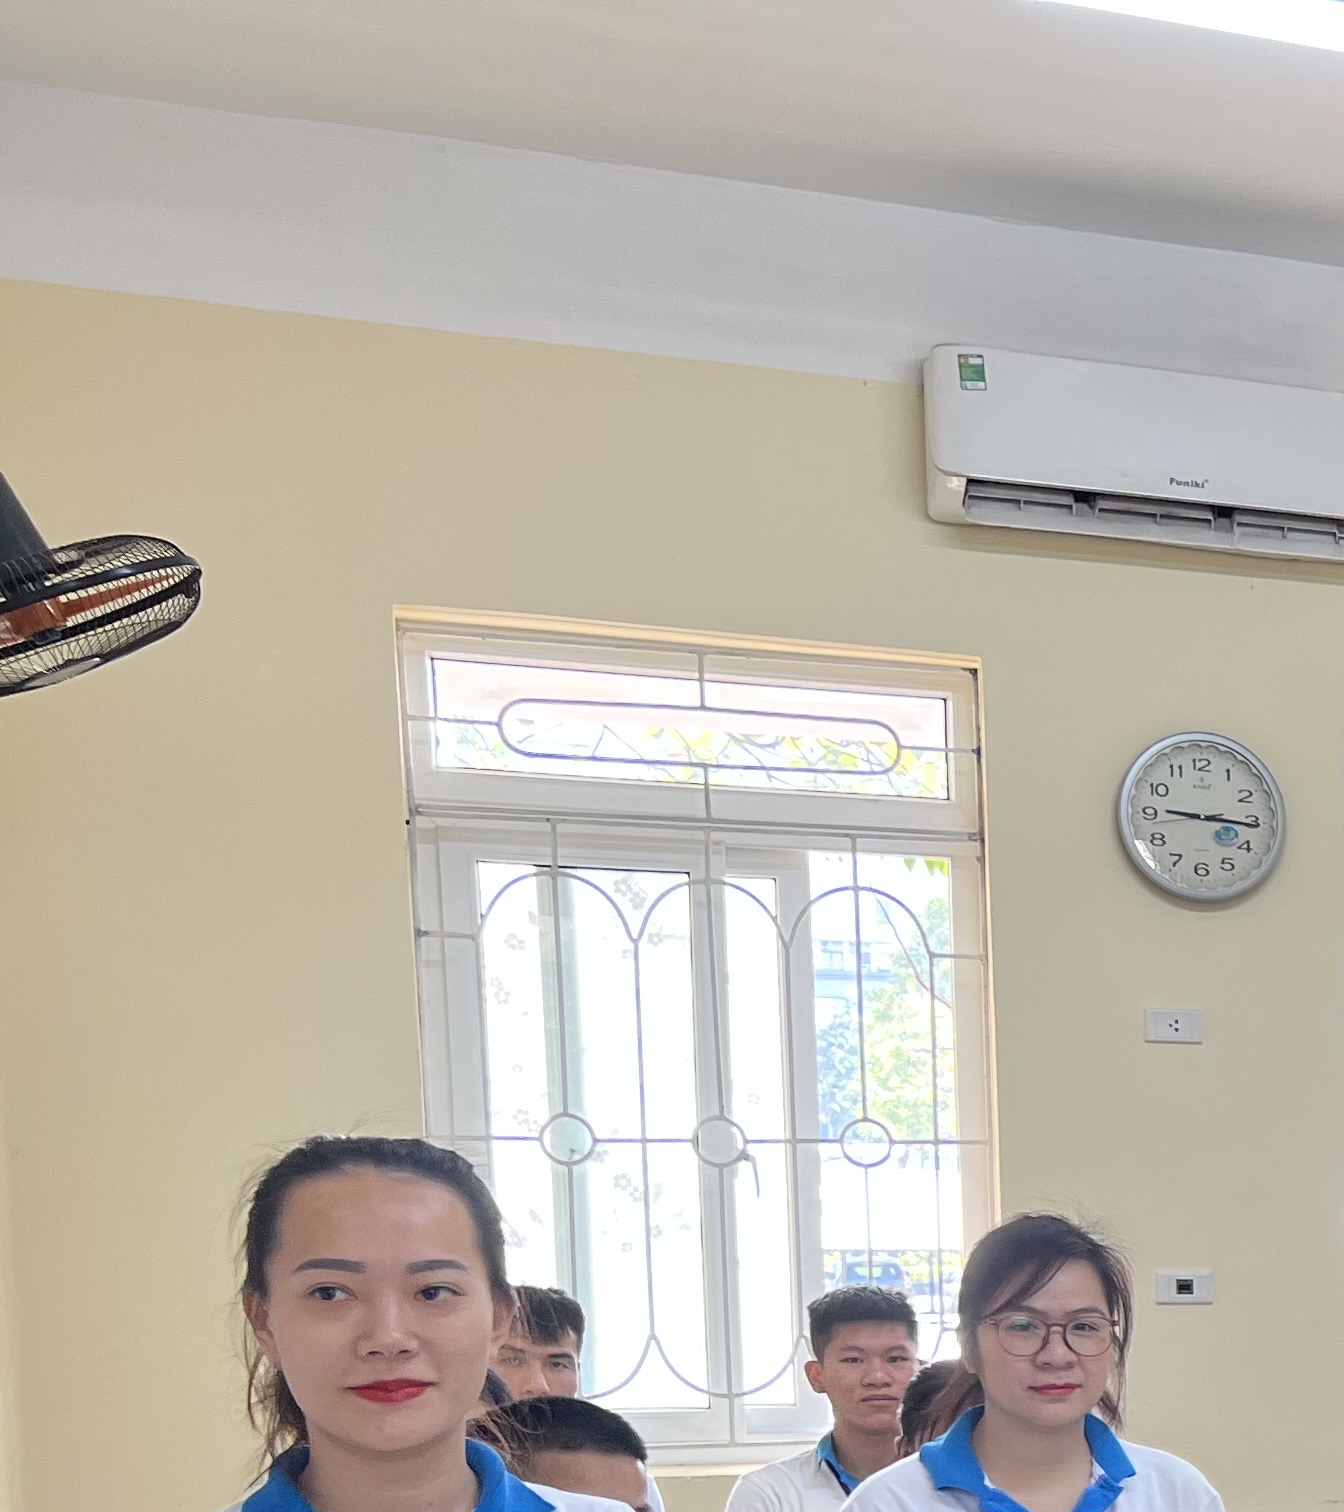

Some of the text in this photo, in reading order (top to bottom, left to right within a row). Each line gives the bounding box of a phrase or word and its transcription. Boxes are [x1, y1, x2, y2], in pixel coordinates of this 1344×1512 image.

[1169, 764, 1183, 779] 11
[1191, 758, 1212, 773] 12
[1225, 768, 1231, 782] 1
[1149, 782, 1170, 797] 10
[1237, 789, 1254, 804] 2
[1141, 806, 1158, 821] 9
[1244, 814, 1261, 829] 3
[1149, 832, 1167, 847] 8
[1237, 840, 1253, 854] 4
[1168, 853, 1183, 868] 7
[1219, 857, 1236, 872] 5
[1193, 862, 1210, 877] 6
